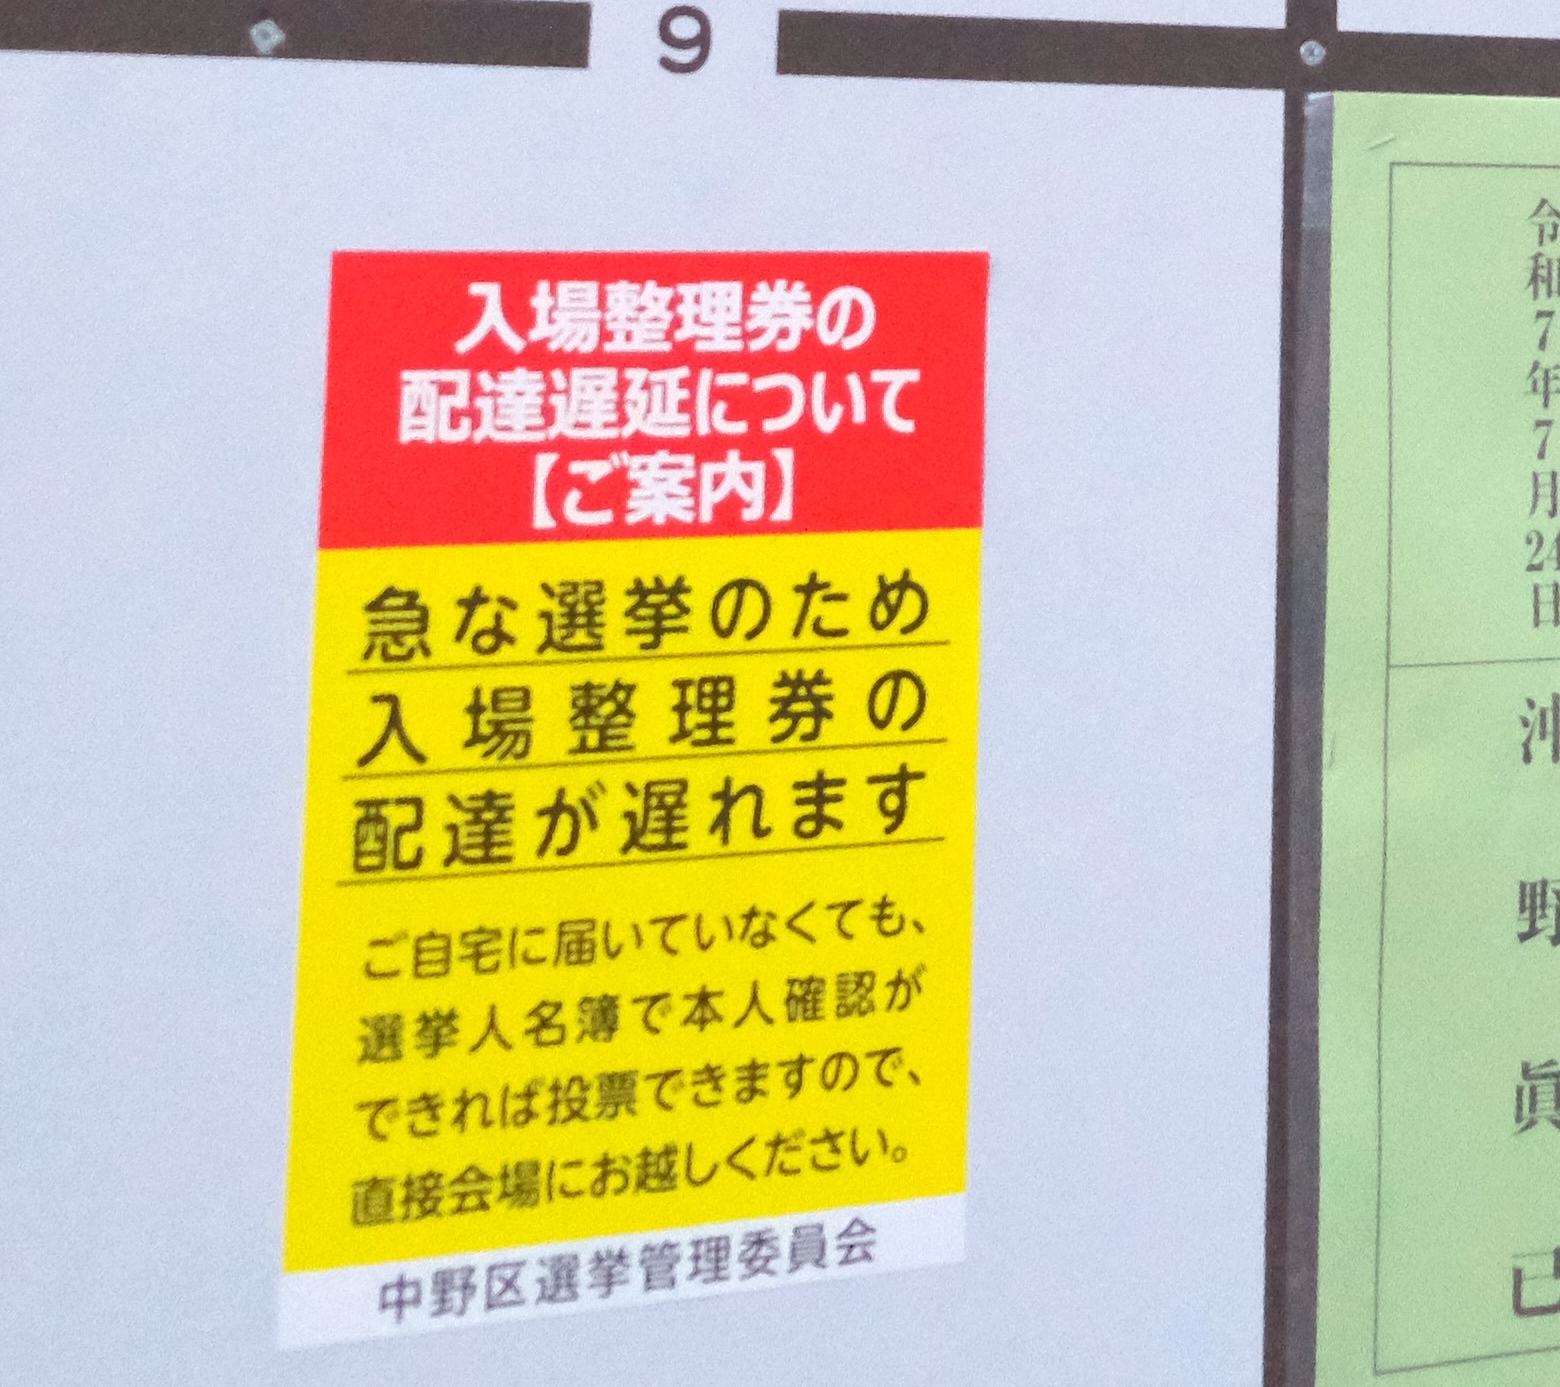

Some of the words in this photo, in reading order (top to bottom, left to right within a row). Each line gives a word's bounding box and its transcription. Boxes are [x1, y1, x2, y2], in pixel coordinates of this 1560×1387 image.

[657, 5, 713, 73] 9
[454, 280, 876, 354] 入場整理券の
[398, 368, 921, 444] 配達遅延について
[532, 449, 795, 529] 【ご案内】
[361, 569, 931, 665] 急な選挙のため
[355, 668, 930, 770] 入場整理券の
[351, 763, 927, 875] 配達が遅れます
[363, 893, 926, 981] ご自宅に届いていなくても、
[357, 966, 927, 1065] 選挙人名簿で本人確認が
[355, 1046, 923, 1143] できれば投票できますので、
[350, 1125, 909, 1228] 直接会場にお越しください。
[378, 1217, 878, 1325] 中野区選挙管理委員会
